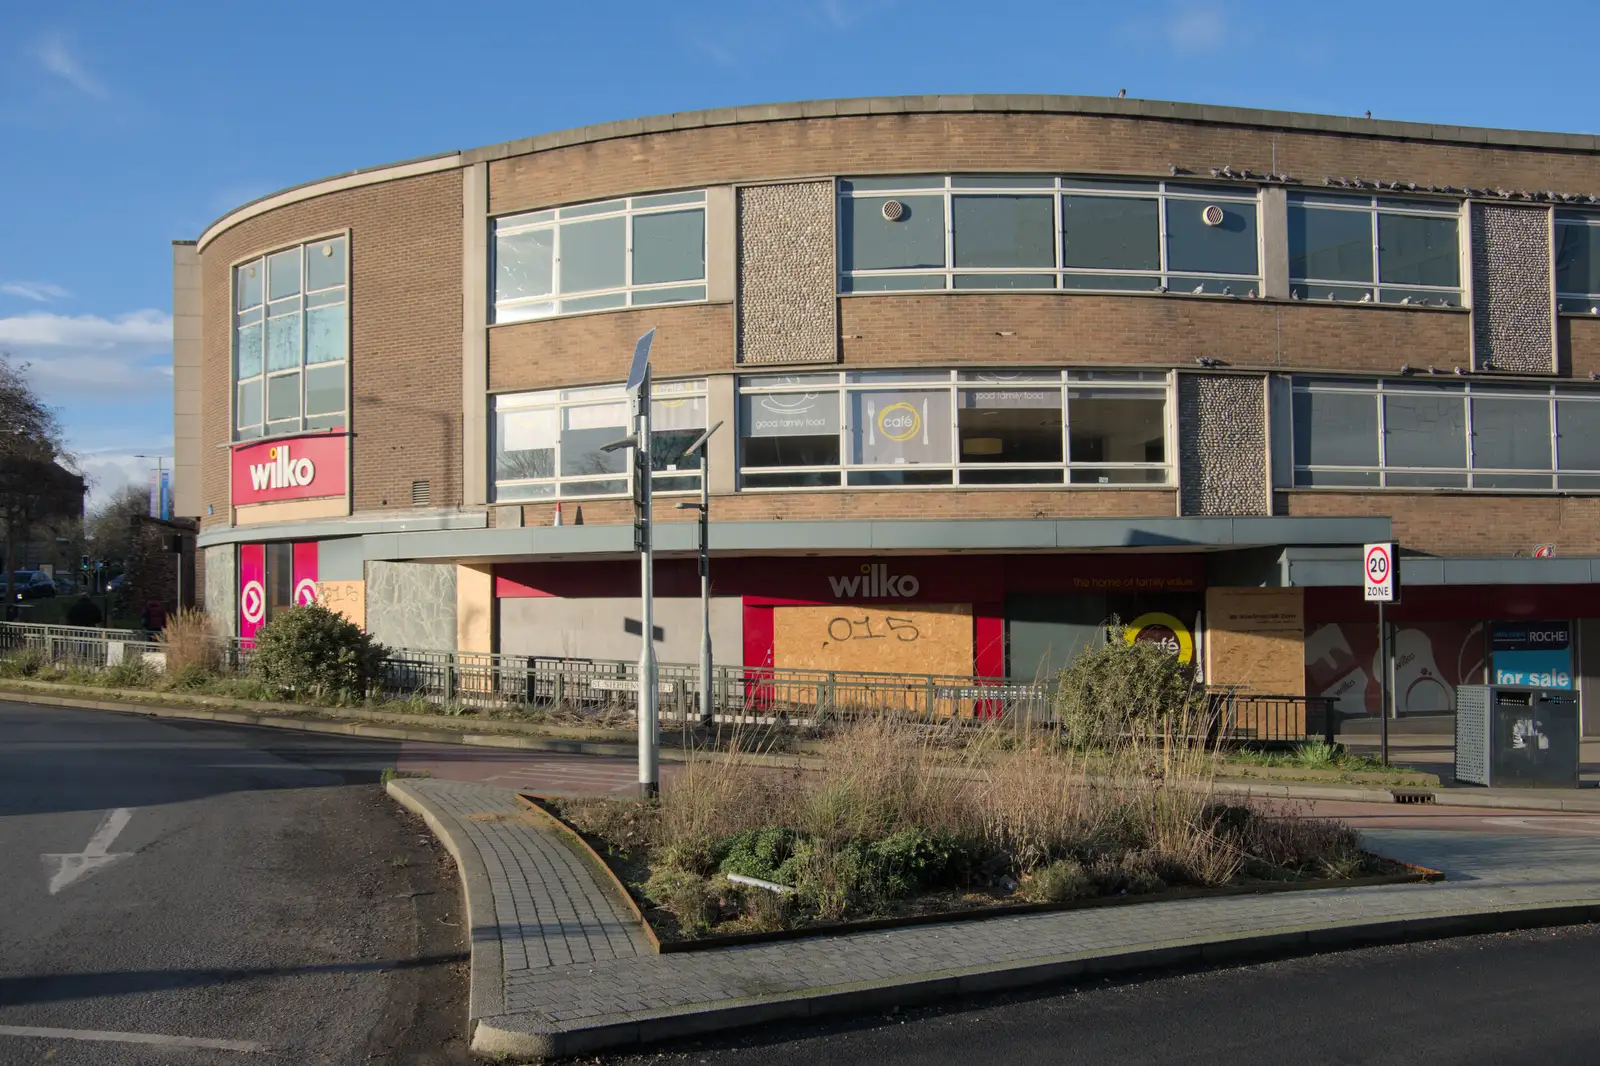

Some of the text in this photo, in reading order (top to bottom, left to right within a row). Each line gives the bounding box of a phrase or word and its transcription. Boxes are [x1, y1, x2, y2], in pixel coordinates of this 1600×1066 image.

[755, 417, 826, 430] good family food
[883, 415, 913, 428] café
[249, 445, 316, 491] wilko
[1370, 557, 1386, 573] 20
[828, 563, 920, 598] wilko
[1073, 577, 1090, 588] The
[1092, 577, 1121, 588] home
[1124, 577, 1134, 587] of
[1136, 577, 1165, 589] family
[1367, 586, 1389, 597] ZONE
[1496, 668, 1569, 687] for sale
[1334, 679, 1356, 696] wilko
